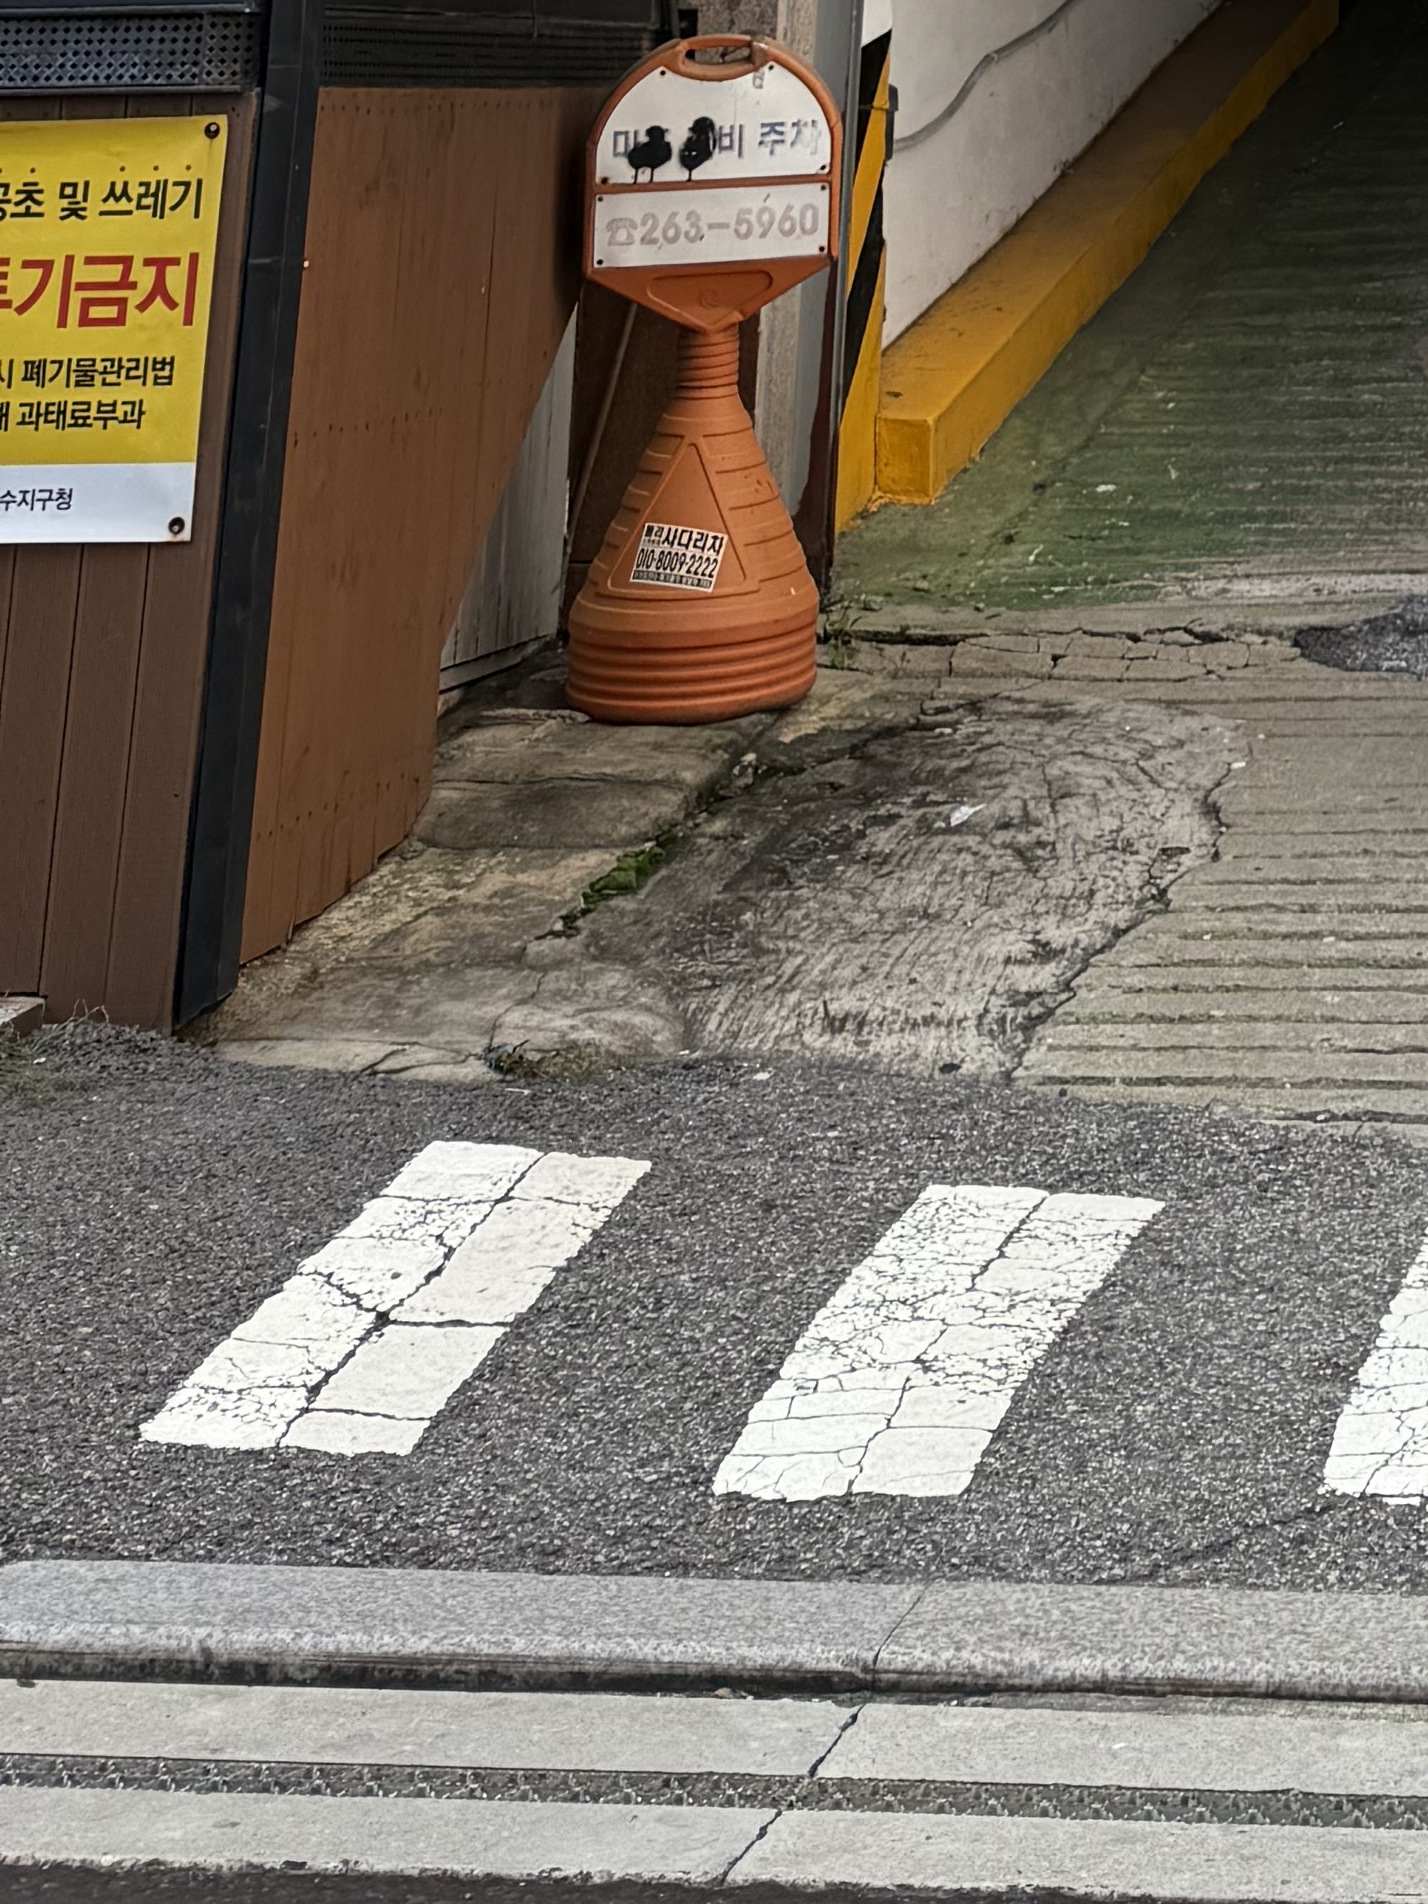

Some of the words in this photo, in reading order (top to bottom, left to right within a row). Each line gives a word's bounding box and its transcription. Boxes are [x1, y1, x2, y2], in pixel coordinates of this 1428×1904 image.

[58, 180, 91, 221] 및
[99, 178, 204, 220] 쓰레기
[639, 202, 820, 245] 263-5960
[21, 355, 175, 390] 폐기물관리법
[16, 398, 146, 432] 과태료부과
[0, 487, 73, 512] 수지구청
[635, 548, 719, 579] 010-8009-2222
